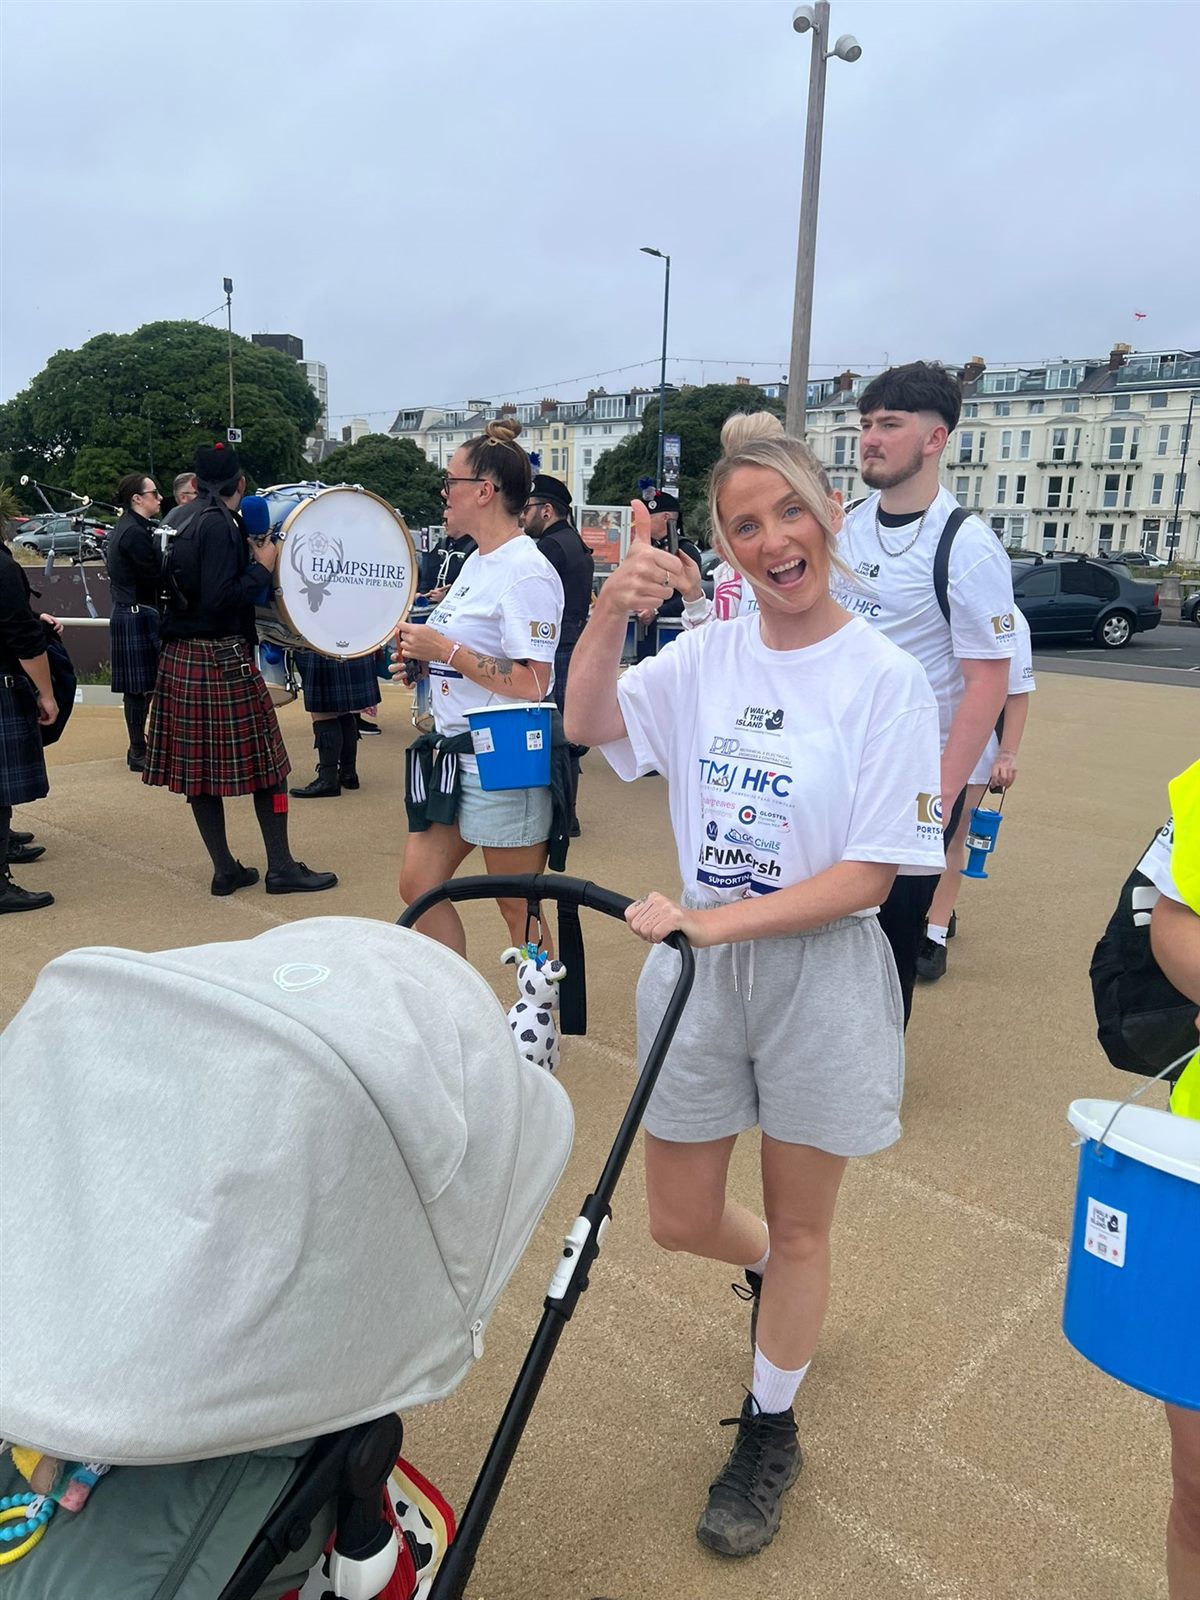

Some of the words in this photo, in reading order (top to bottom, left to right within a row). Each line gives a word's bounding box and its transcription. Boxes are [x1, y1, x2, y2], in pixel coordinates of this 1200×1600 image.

[312, 557, 405, 580] HAMPSHIRE
[313, 573, 364, 585] CALEDONIAN
[365, 578, 381, 587] PIPE
[382, 580, 403, 589] BAND
[853, 599, 882, 617] HFC
[749, 707, 771, 716] WALK
[735, 719, 764, 729] ISLAND
[741, 768, 793, 798] HFC
[760, 810, 787, 821] GLOSTER
[754, 838, 781, 851] Civils
